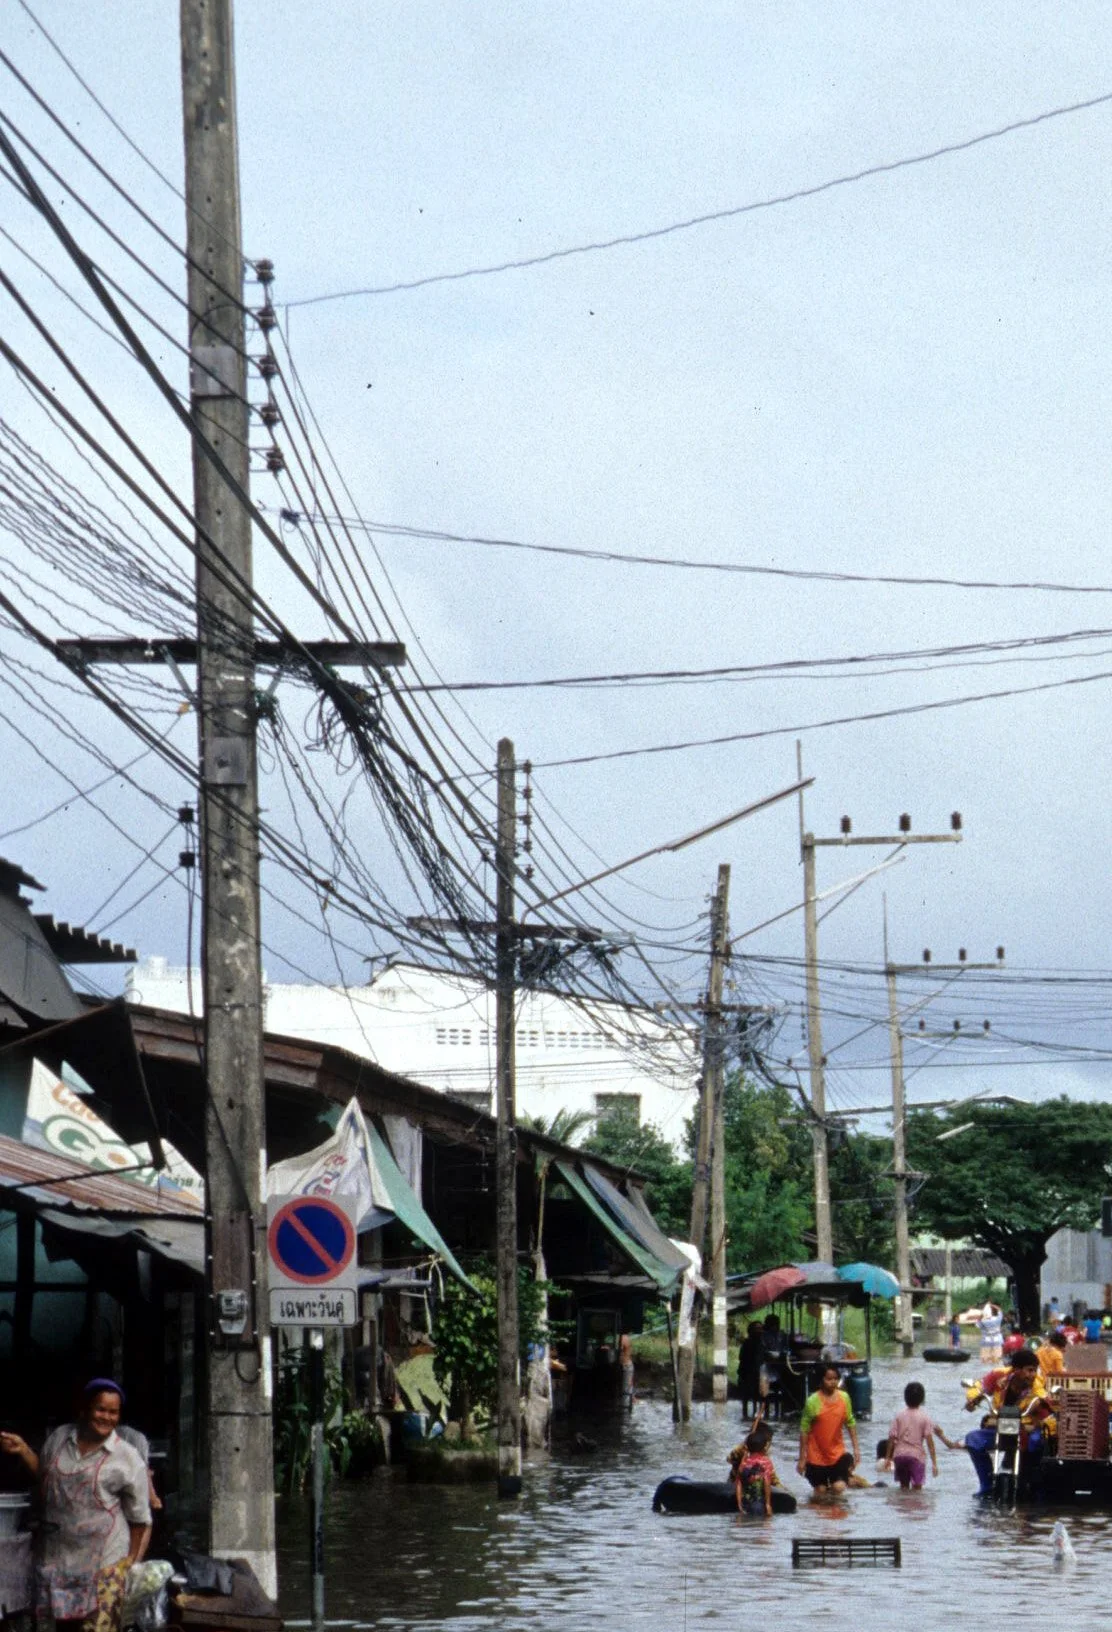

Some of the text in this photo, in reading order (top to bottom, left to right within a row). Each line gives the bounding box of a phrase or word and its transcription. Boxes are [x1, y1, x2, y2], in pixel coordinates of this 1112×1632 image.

[280, 1293, 345, 1324] เฉพาะวันคู่
